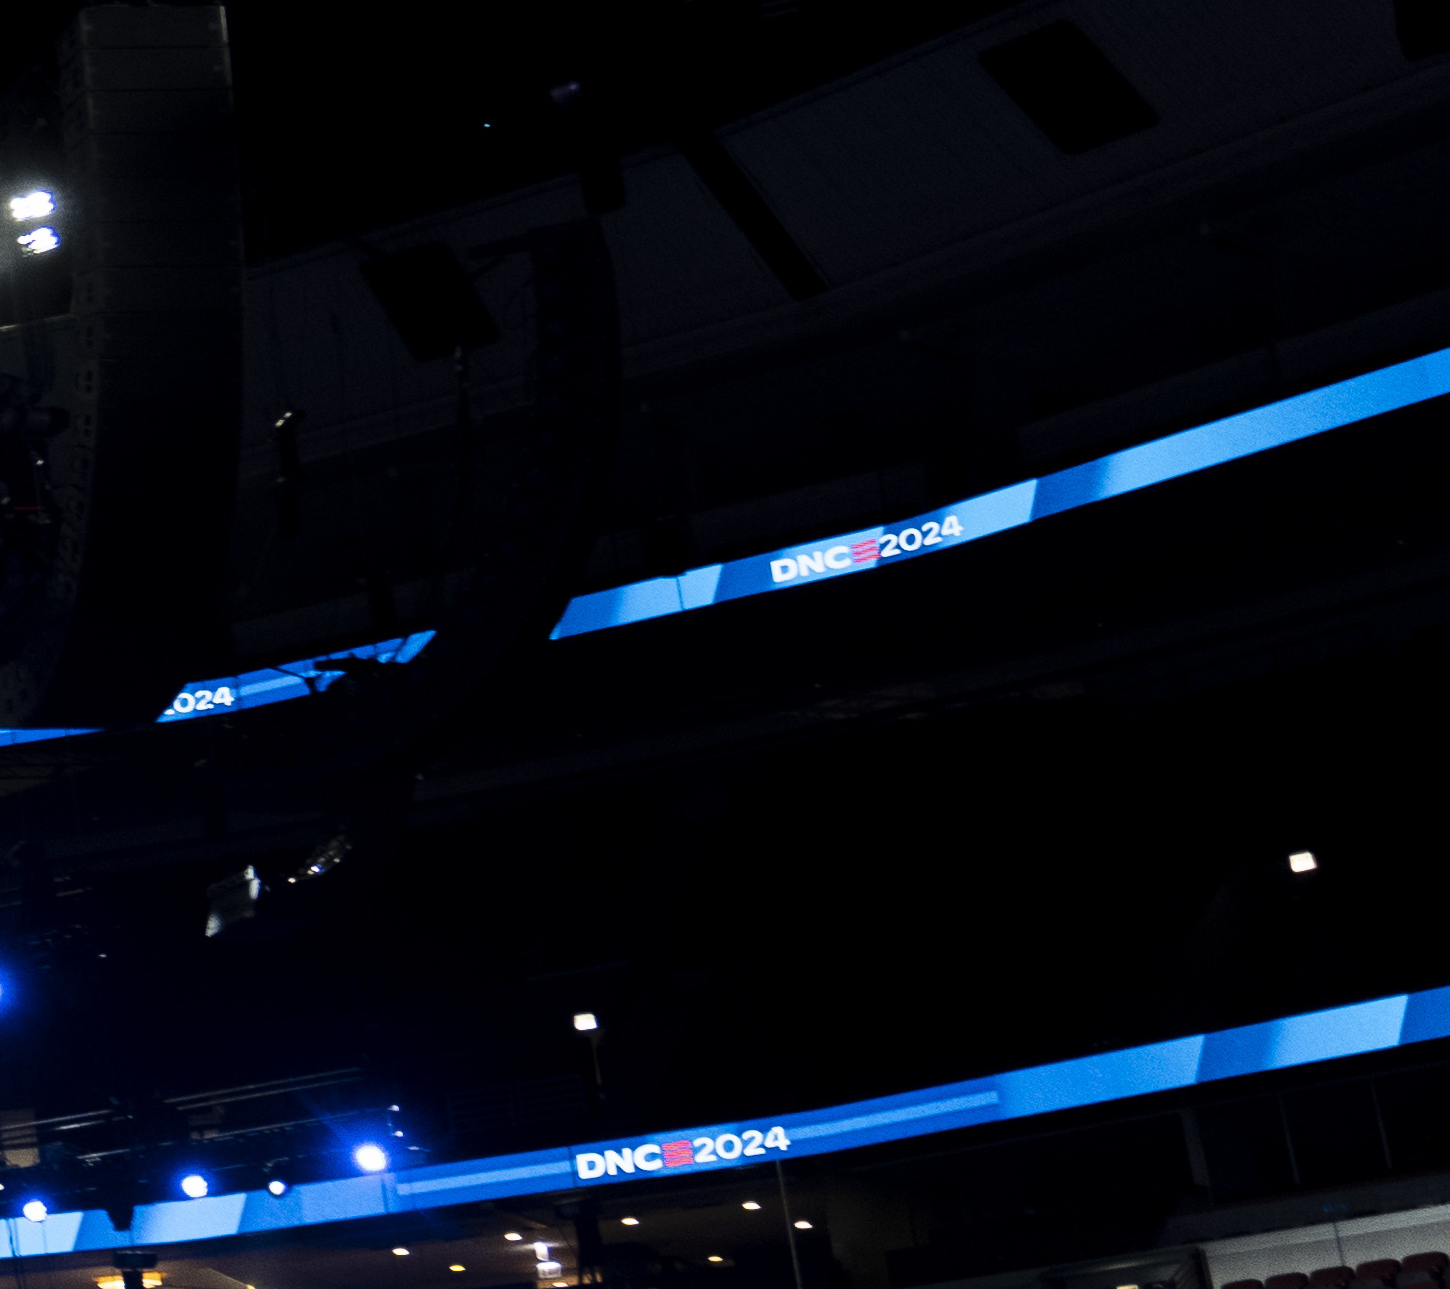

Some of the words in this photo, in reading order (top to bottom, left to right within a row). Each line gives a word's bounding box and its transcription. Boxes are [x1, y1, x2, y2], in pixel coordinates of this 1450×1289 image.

[770, 545, 851, 583] DNC
[878, 515, 964, 558] 2024
[575, 1143, 664, 1180] DNC
[692, 1125, 791, 1163] 2024
